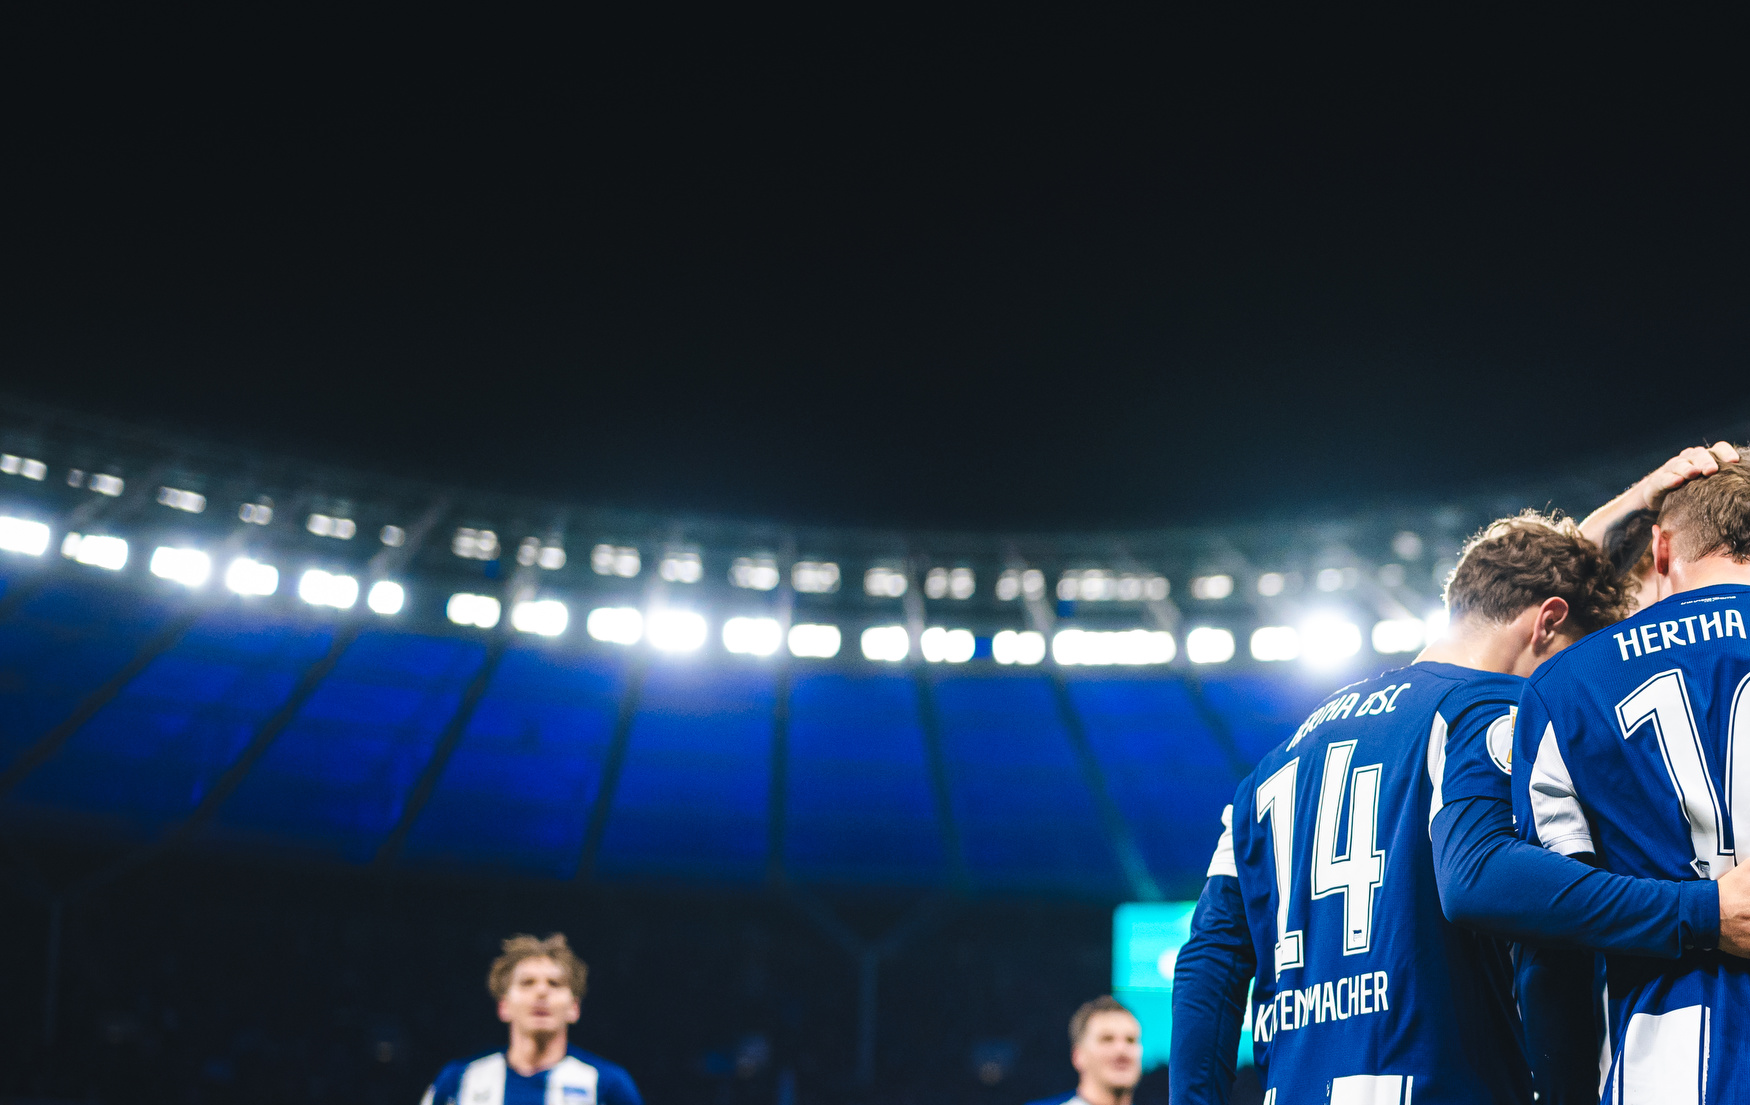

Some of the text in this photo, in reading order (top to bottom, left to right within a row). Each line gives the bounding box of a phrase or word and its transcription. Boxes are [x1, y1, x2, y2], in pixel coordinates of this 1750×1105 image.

[1613, 609, 1747, 662] HERTHA
[1354, 682, 1412, 718] BSC
[1256, 739, 1386, 984] 14
